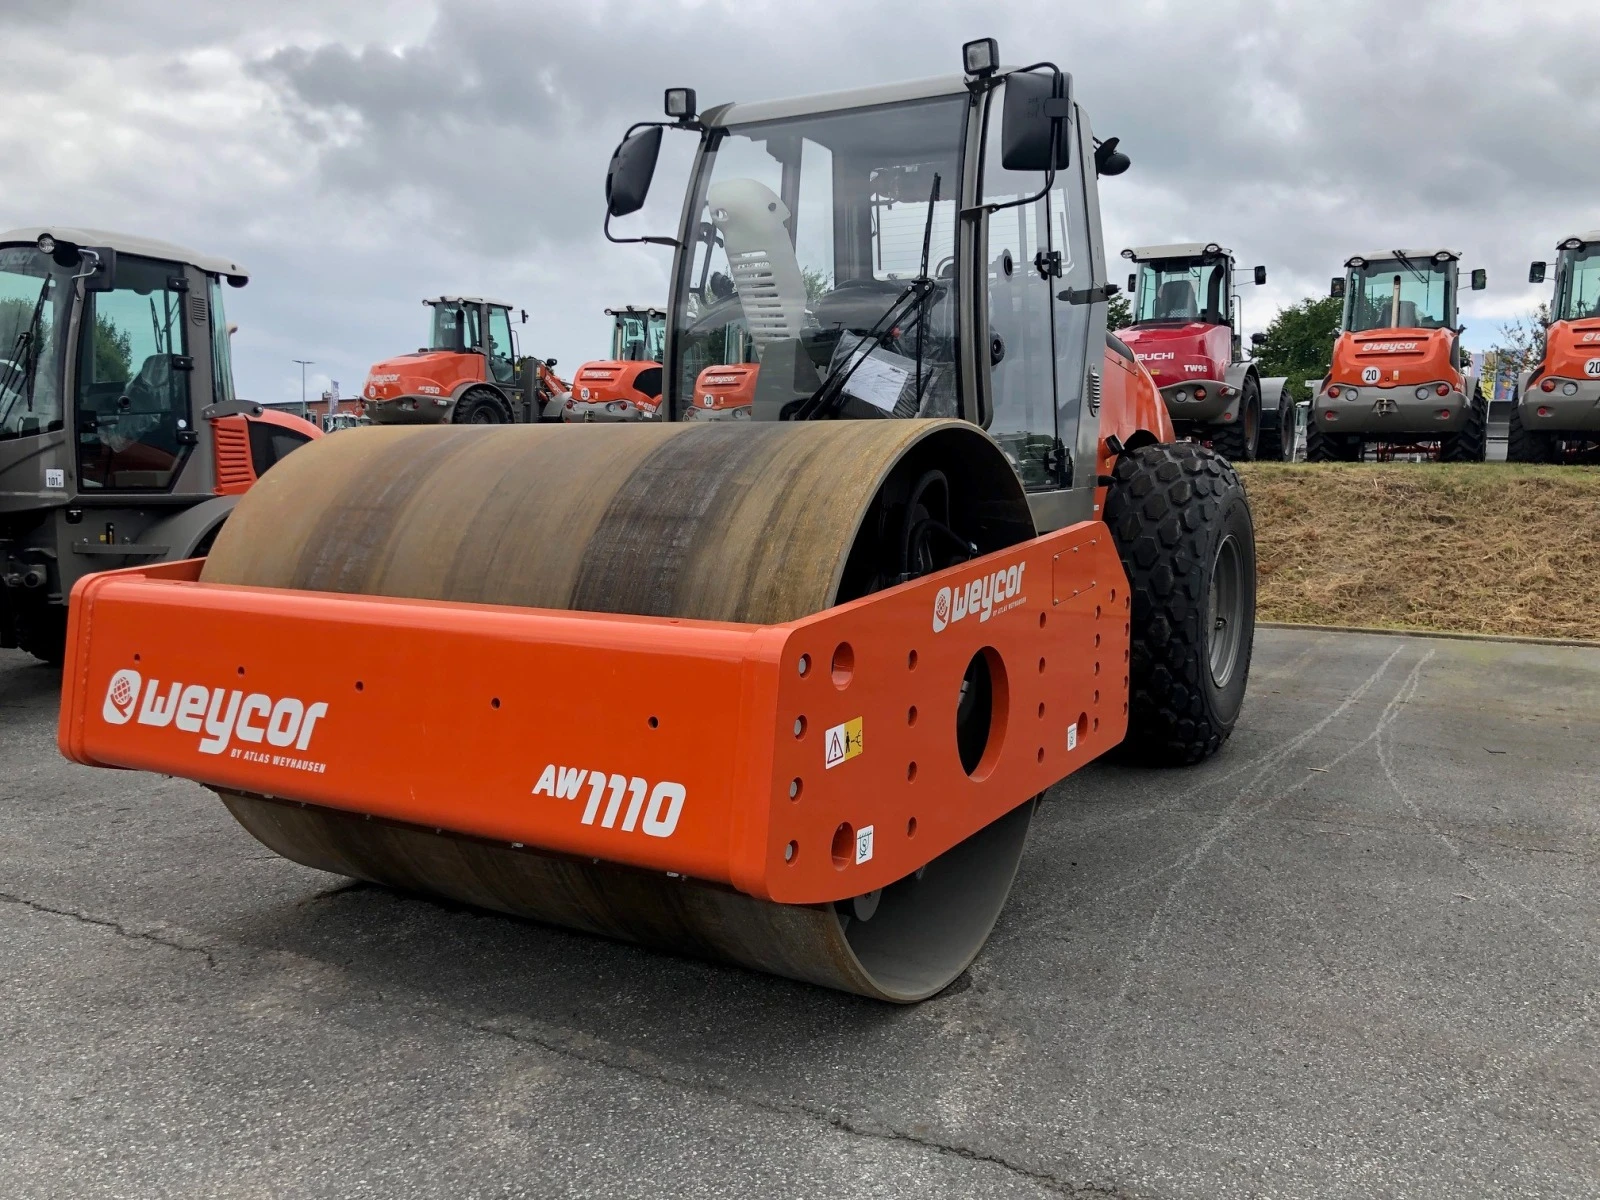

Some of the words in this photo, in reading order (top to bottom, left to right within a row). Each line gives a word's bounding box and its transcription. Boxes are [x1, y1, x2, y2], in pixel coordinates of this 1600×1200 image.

[1372, 342, 1418, 352] weycor
[1184, 364, 1207, 373] TW95
[1365, 369, 1377, 381] 20
[951, 561, 1025, 623] weycor
[137, 679, 329, 754] weycor
[231, 748, 242, 759] BY
[243, 750, 270, 764] ATLAS
[272, 755, 326, 774] WEYHAUSEN
